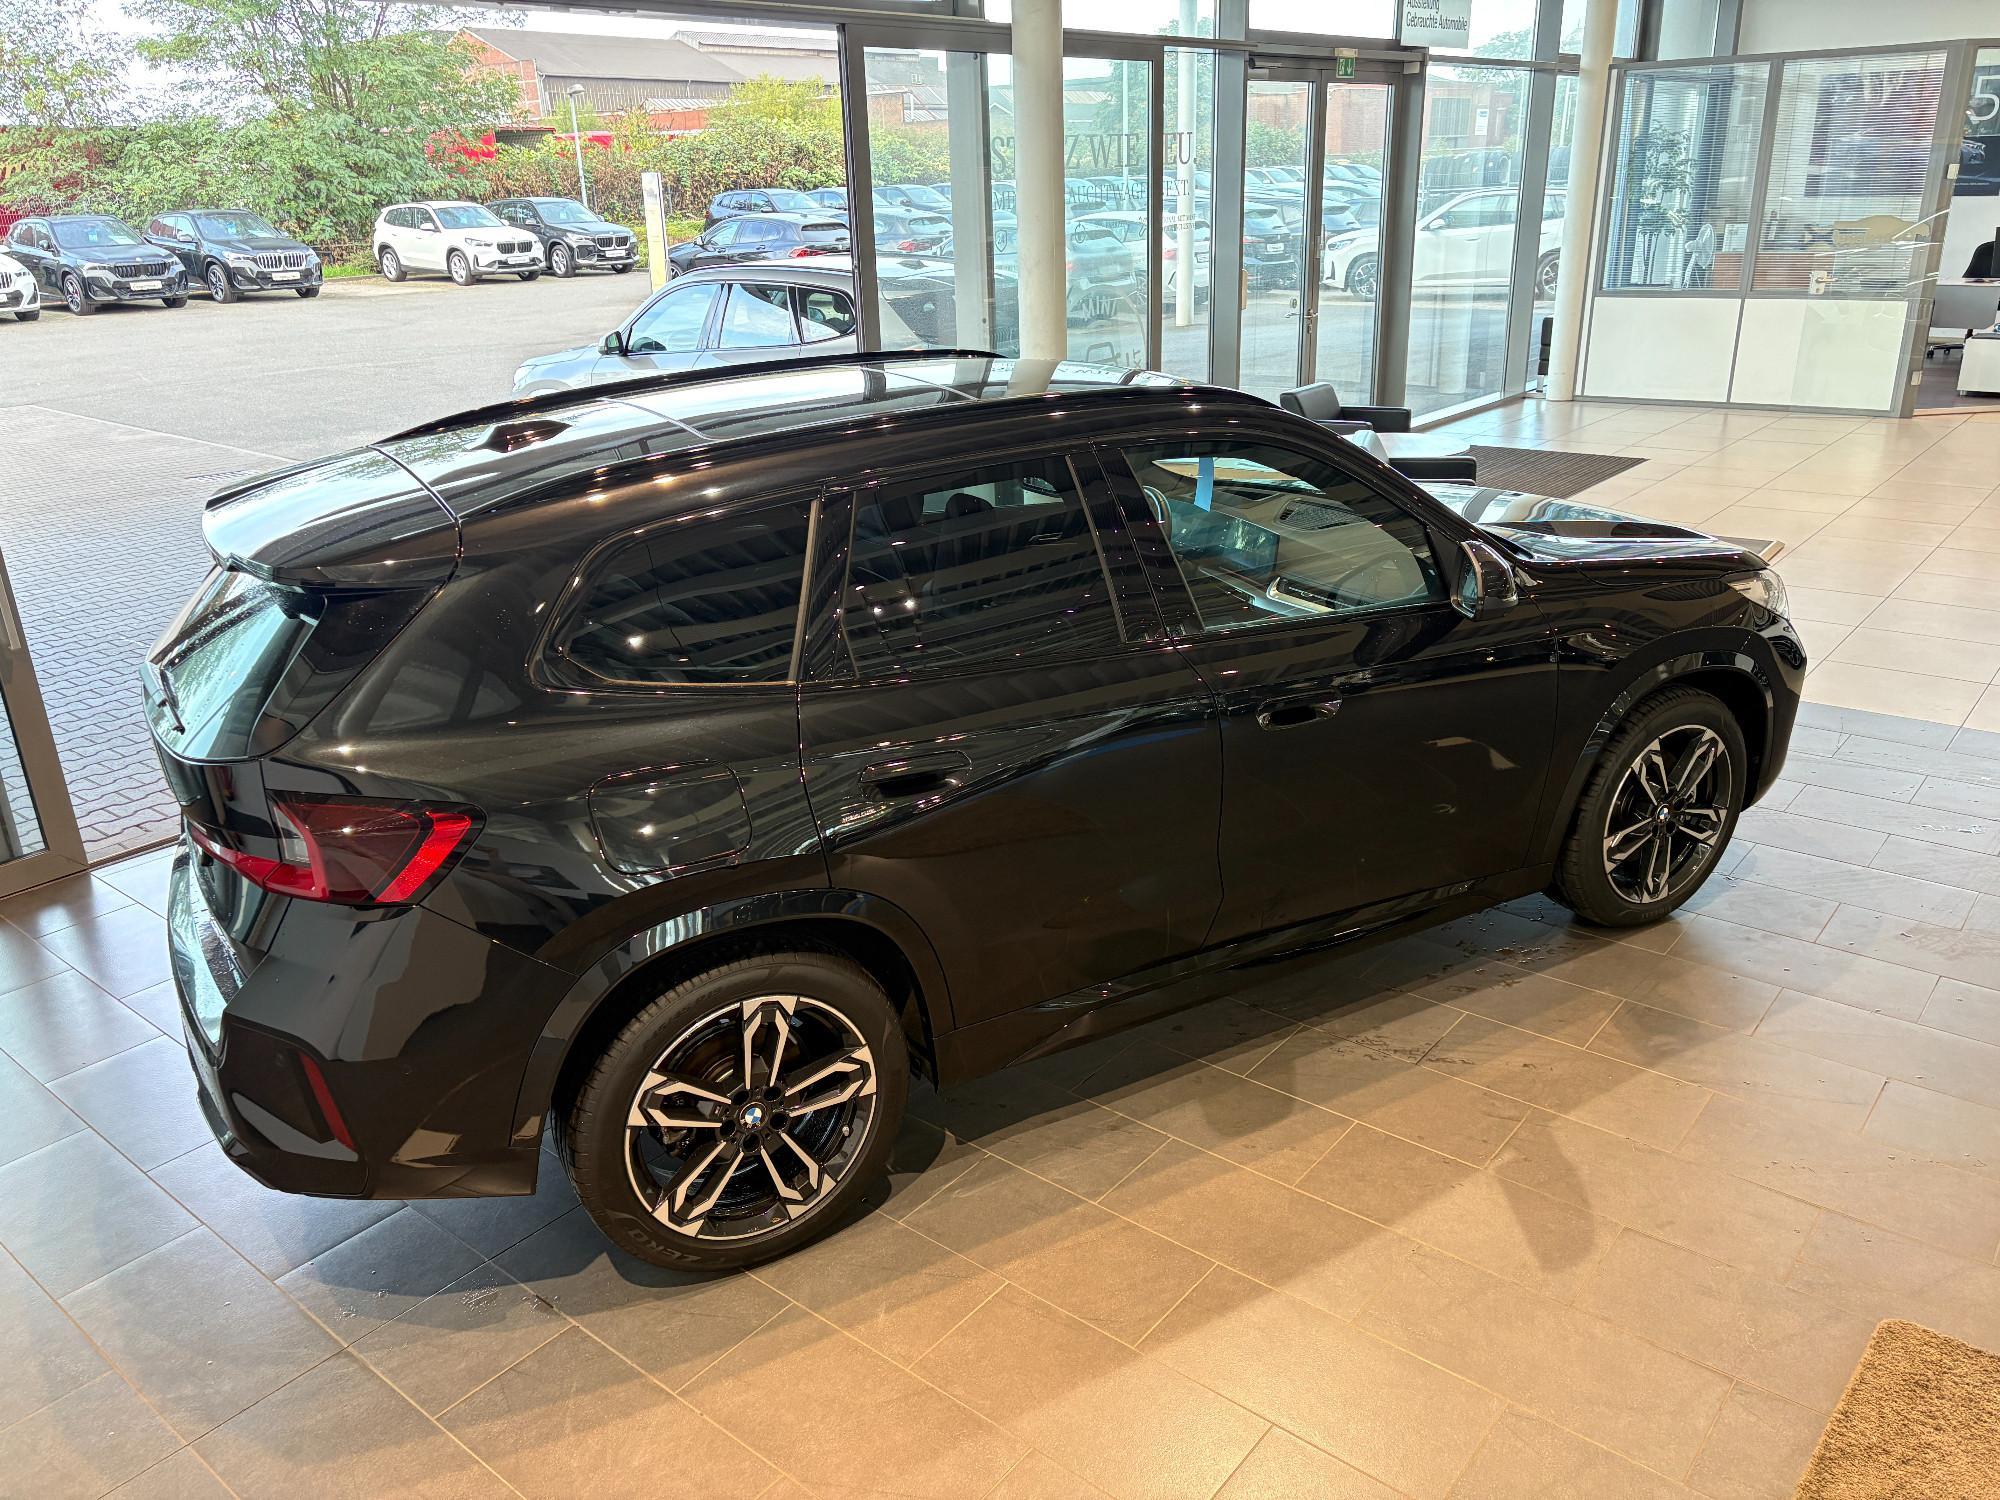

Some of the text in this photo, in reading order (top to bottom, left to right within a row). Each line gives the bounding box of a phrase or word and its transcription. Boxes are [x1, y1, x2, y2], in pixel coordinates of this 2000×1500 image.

[1406, 11, 1468, 31] Gebrauchte Automobile
[1971, 74, 2000, 122] 5
